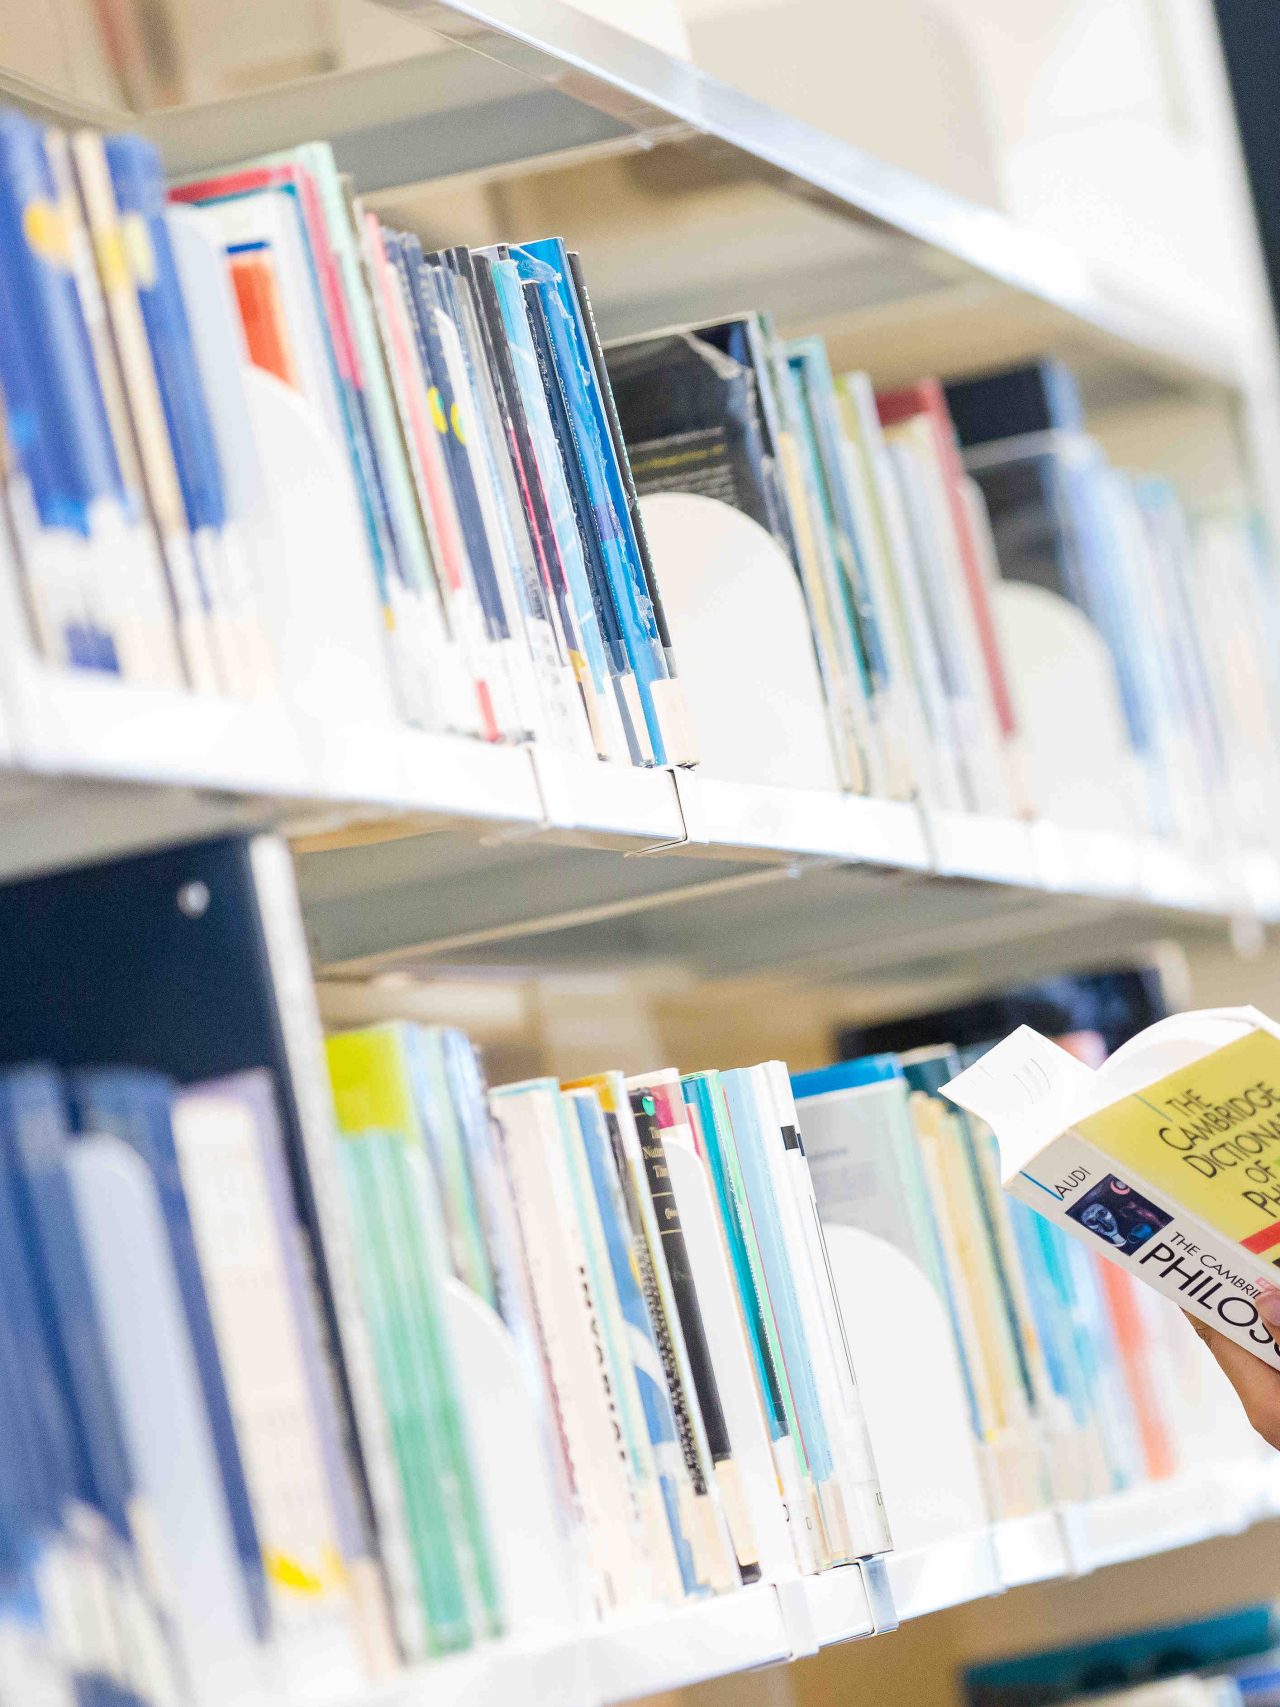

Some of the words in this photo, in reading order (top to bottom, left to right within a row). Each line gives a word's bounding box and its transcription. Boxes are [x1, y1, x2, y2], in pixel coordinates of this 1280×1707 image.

[1165, 1088, 1213, 1118] THE
[1053, 1165, 1091, 1199] AUDI
[1245, 1159, 1277, 1184] OF
[1169, 1231, 1201, 1258] THE
